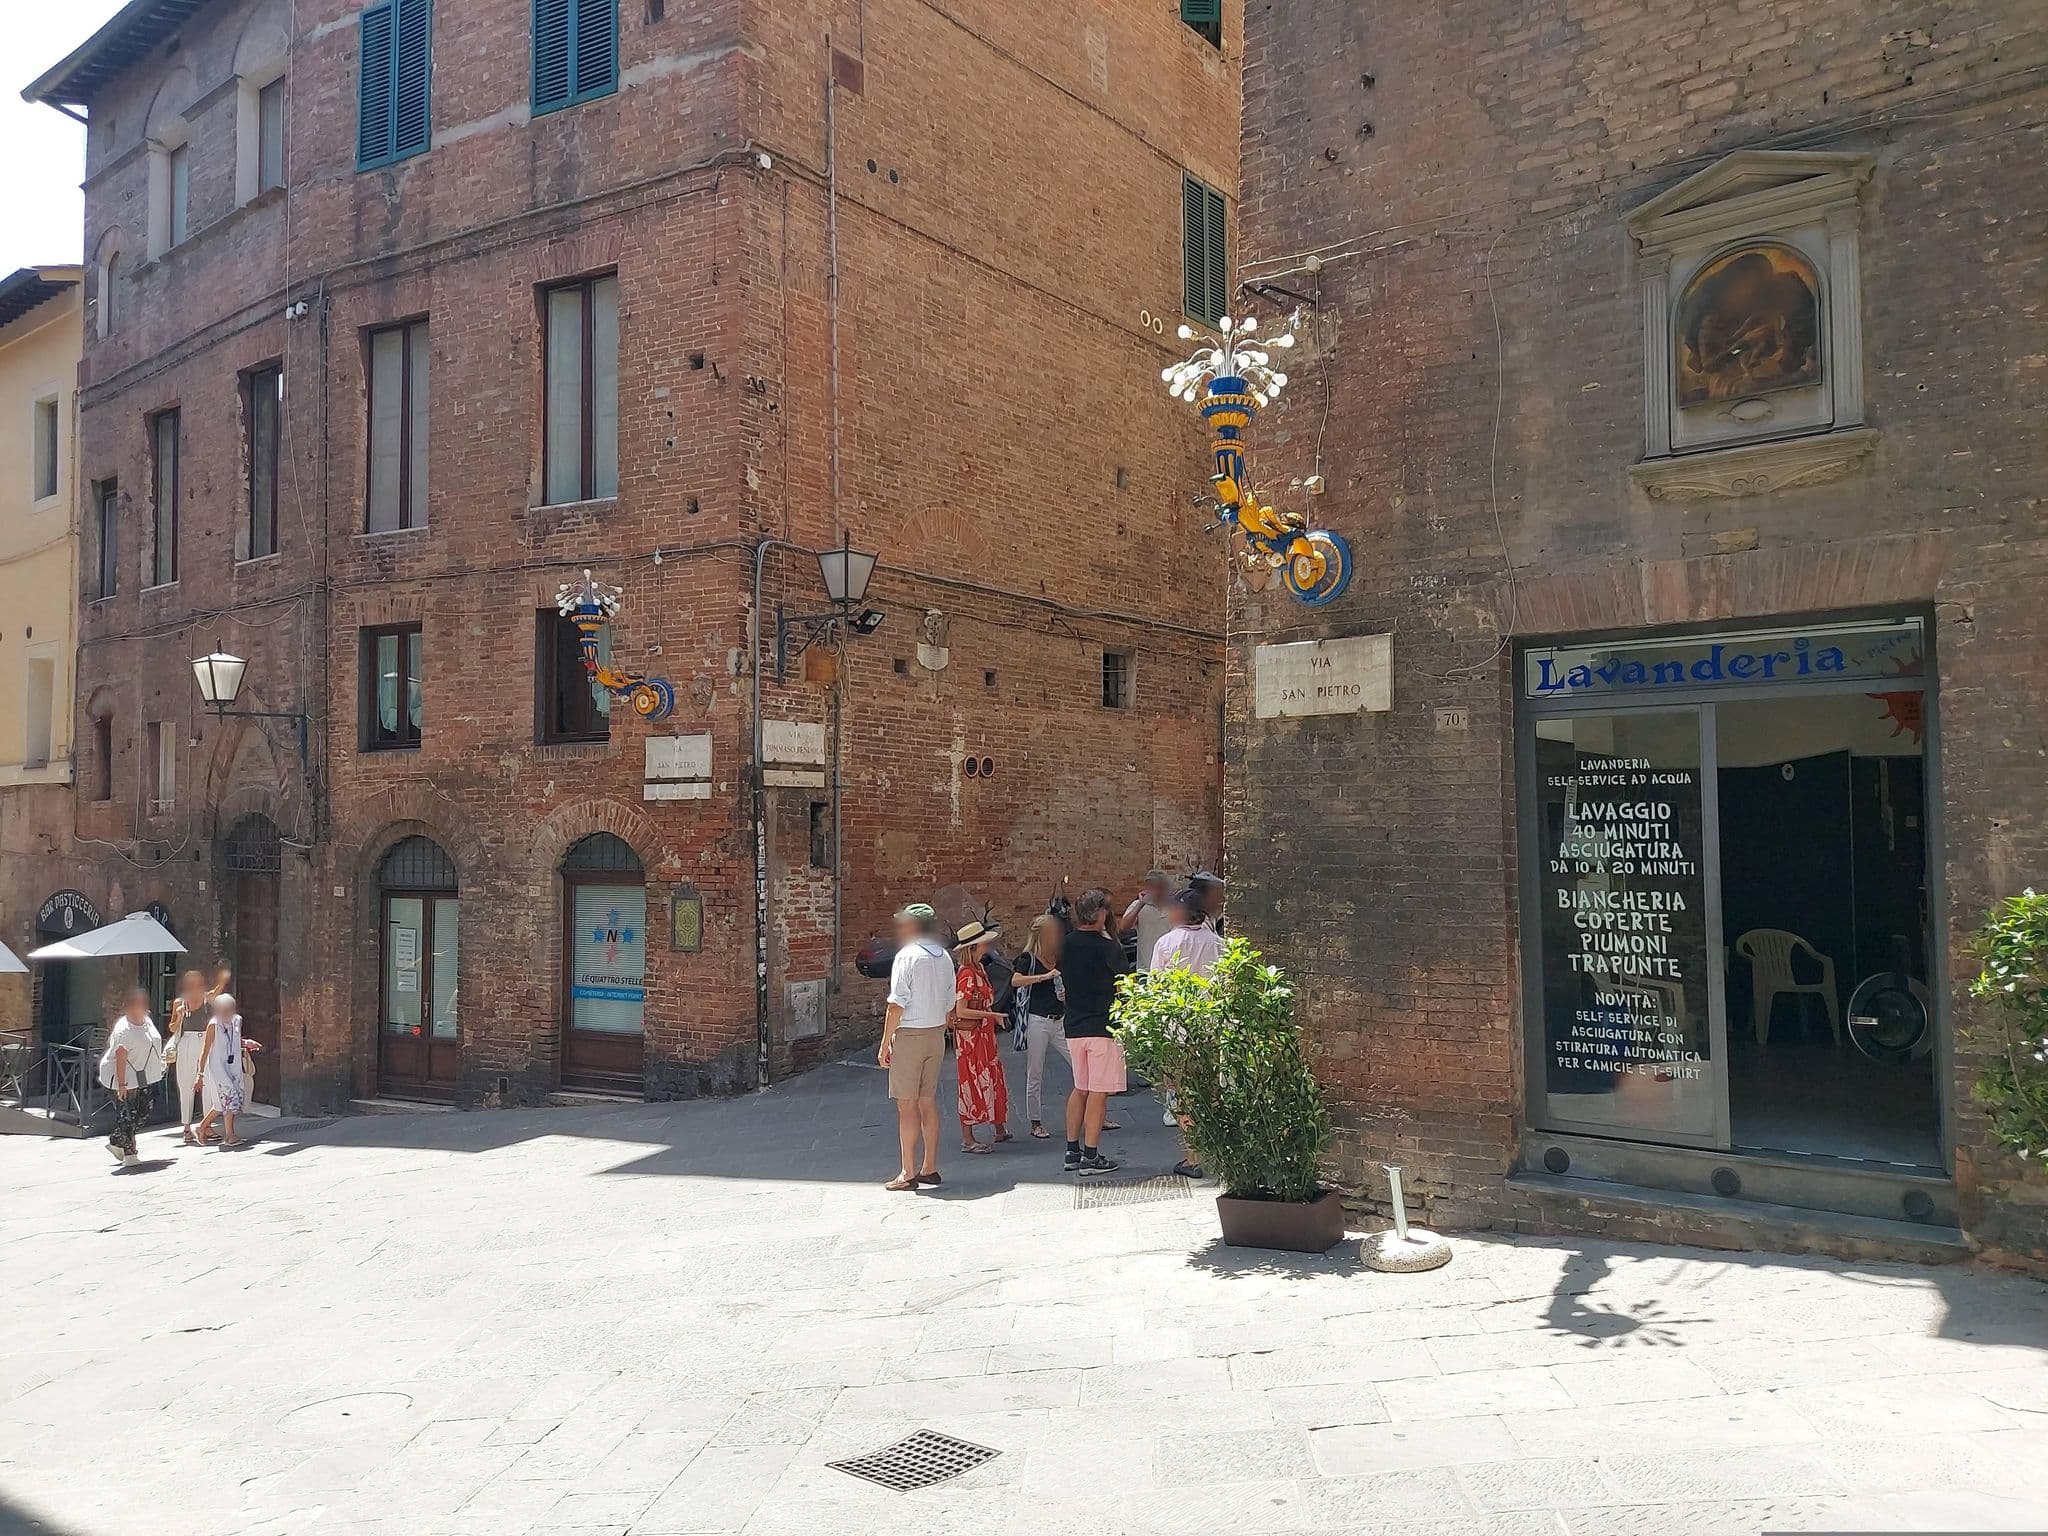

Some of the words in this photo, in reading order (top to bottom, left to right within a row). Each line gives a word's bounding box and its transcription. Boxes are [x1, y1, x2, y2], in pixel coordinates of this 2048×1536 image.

[1310, 657, 1332, 669] VIA
[1536, 637, 1848, 692] Lavanderia
[1282, 689, 1306, 700] SAN
[1317, 684, 1361, 699] PIETRO
[1443, 712, 1460, 726] 70
[1580, 758, 1650, 771] LAVANDERIA
[1547, 775, 1574, 786] SELF
[1578, 774, 1627, 786] SERVICE
[1631, 774, 1647, 785] AD
[1652, 773, 1692, 785] ACQUA
[1568, 802, 1671, 821] LAVAGGIO
[1571, 824, 1596, 839] 40
[1604, 823, 1670, 840] MINUTI
[1559, 841, 1684, 859] ASCIUGATURA
[1550, 860, 1569, 874] DA
[1575, 861, 1590, 874] 10
[1596, 860, 1606, 874] A
[1612, 861, 1635, 874] 20
[1641, 860, 1696, 876] MINUTI
[1557, 888, 1686, 912] BIANCHERIA
[40, 899, 55, 922] BAR
[54, 893, 100, 927] PASTICCERIA
[154, 906, 168, 926] AR
[1573, 911, 1673, 933] COPERTE
[606, 929, 618, 943] N
[1580, 932, 1667, 954] PIUMONI
[1567, 954, 1682, 978] TRAPUNTE
[581, 974, 590, 982] LE
[590, 975, 620, 984] QUATTRO
[621, 977, 643, 986] STELLE
[1594, 991, 1657, 1009] NOVITÀ:
[1576, 1010, 1604, 1022] SELF
[1608, 1013, 1660, 1027] SERVICE
[1666, 1016, 1678, 1028] DI
[1571, 1025, 1653, 1043] ASCIUGATURA
[1657, 1032, 1685, 1046] CON
[1555, 1041, 1619, 1057] STIRATURA
[1624, 1046, 1702, 1063] AUTOMATICA
[1557, 1056, 1580, 1069] PER
[1584, 1059, 1634, 1074] CAMICIE
[1639, 1064, 1647, 1076] E
[1651, 1065, 1702, 1080] T-SHIRT
